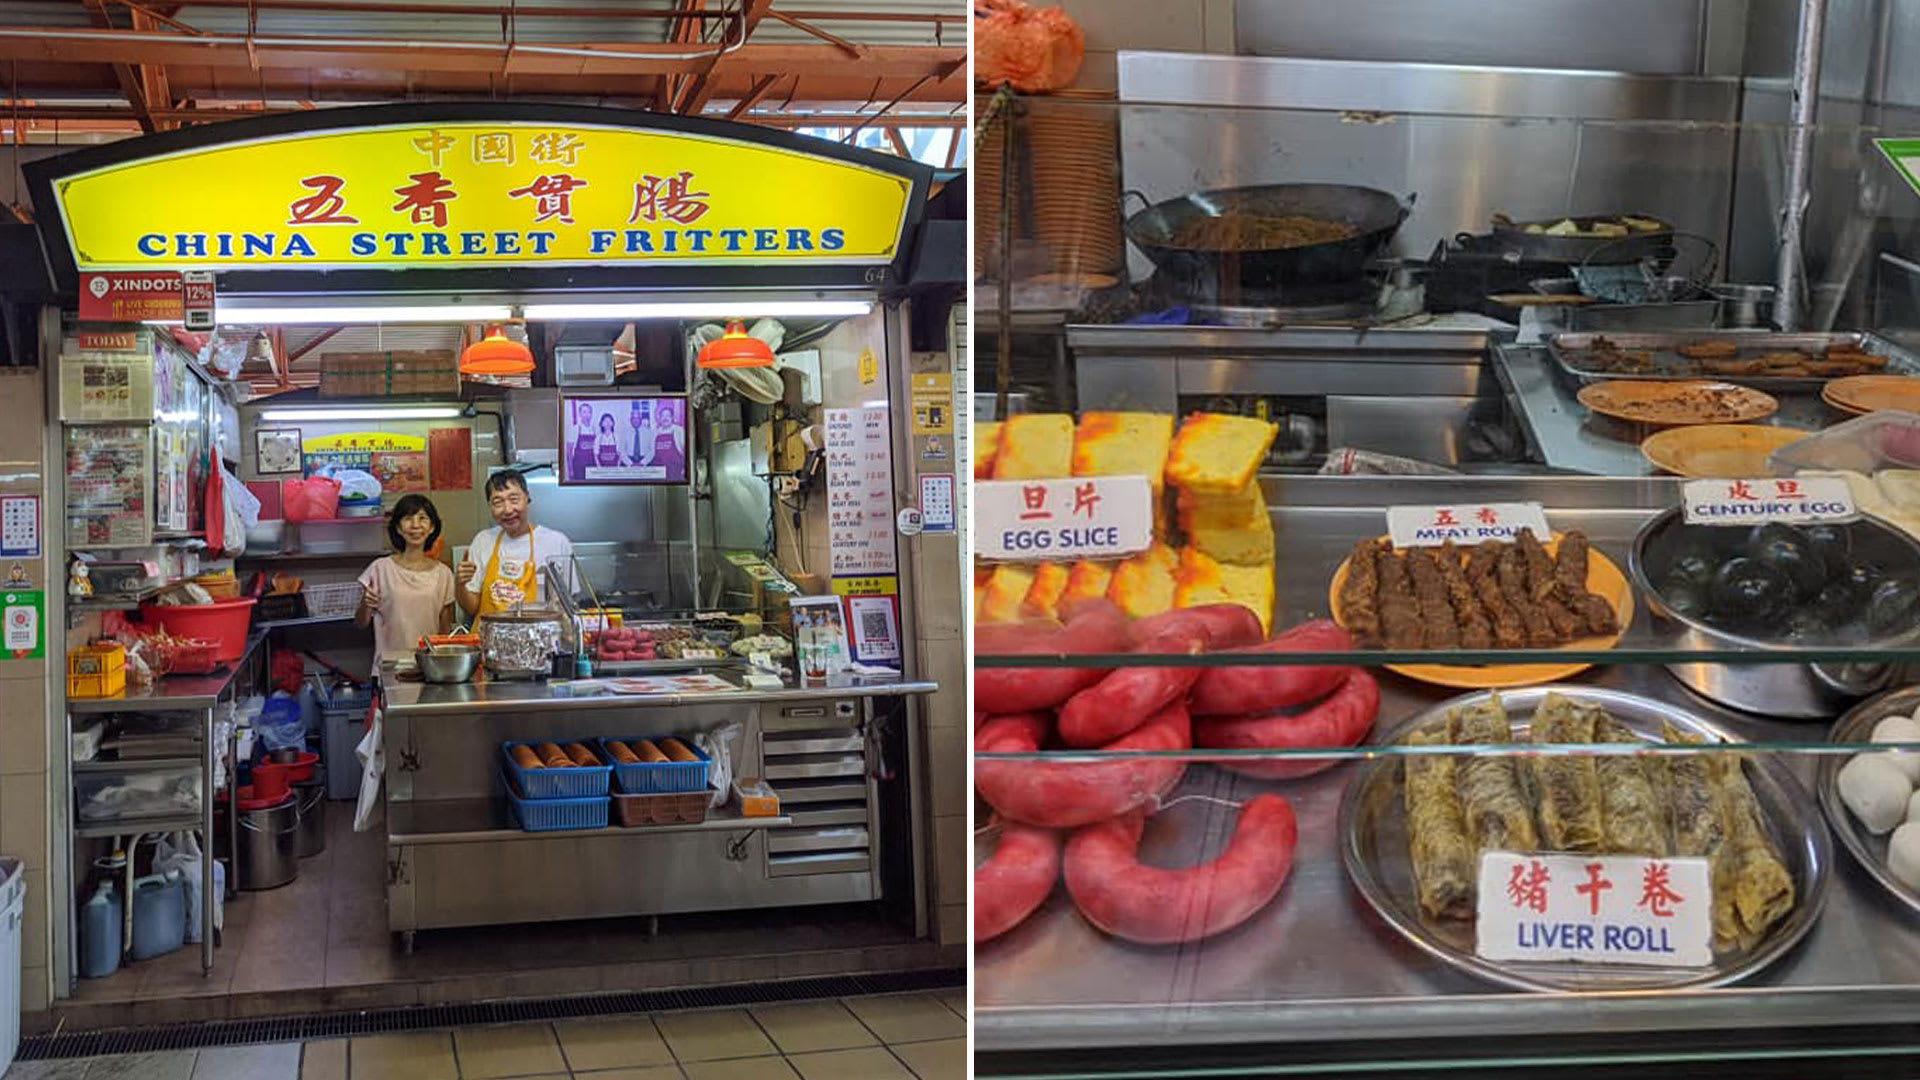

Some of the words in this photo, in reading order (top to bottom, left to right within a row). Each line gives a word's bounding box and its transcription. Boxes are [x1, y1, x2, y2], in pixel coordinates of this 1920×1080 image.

[413, 129, 586, 165] 中國街
[137, 233, 316, 256] CHINA
[351, 231, 556, 256] STREET
[590, 228, 845, 254] FRITTERS
[864, 267, 888, 283] 64
[113, 279, 182, 291] XINDOTS
[186, 286, 213, 299] 12%
[87, 336, 128, 347] TODAY
[1020, 482, 1102, 519] 旦片
[1695, 503, 1793, 516] CENTURY
[1801, 502, 1846, 514] EGG
[1003, 531, 1052, 550] EGG
[1058, 527, 1118, 548] SLICE
[1416, 527, 1471, 539] MEAT
[1517, 922, 1595, 950] LIVER
[1604, 924, 1675, 953] ROLL
